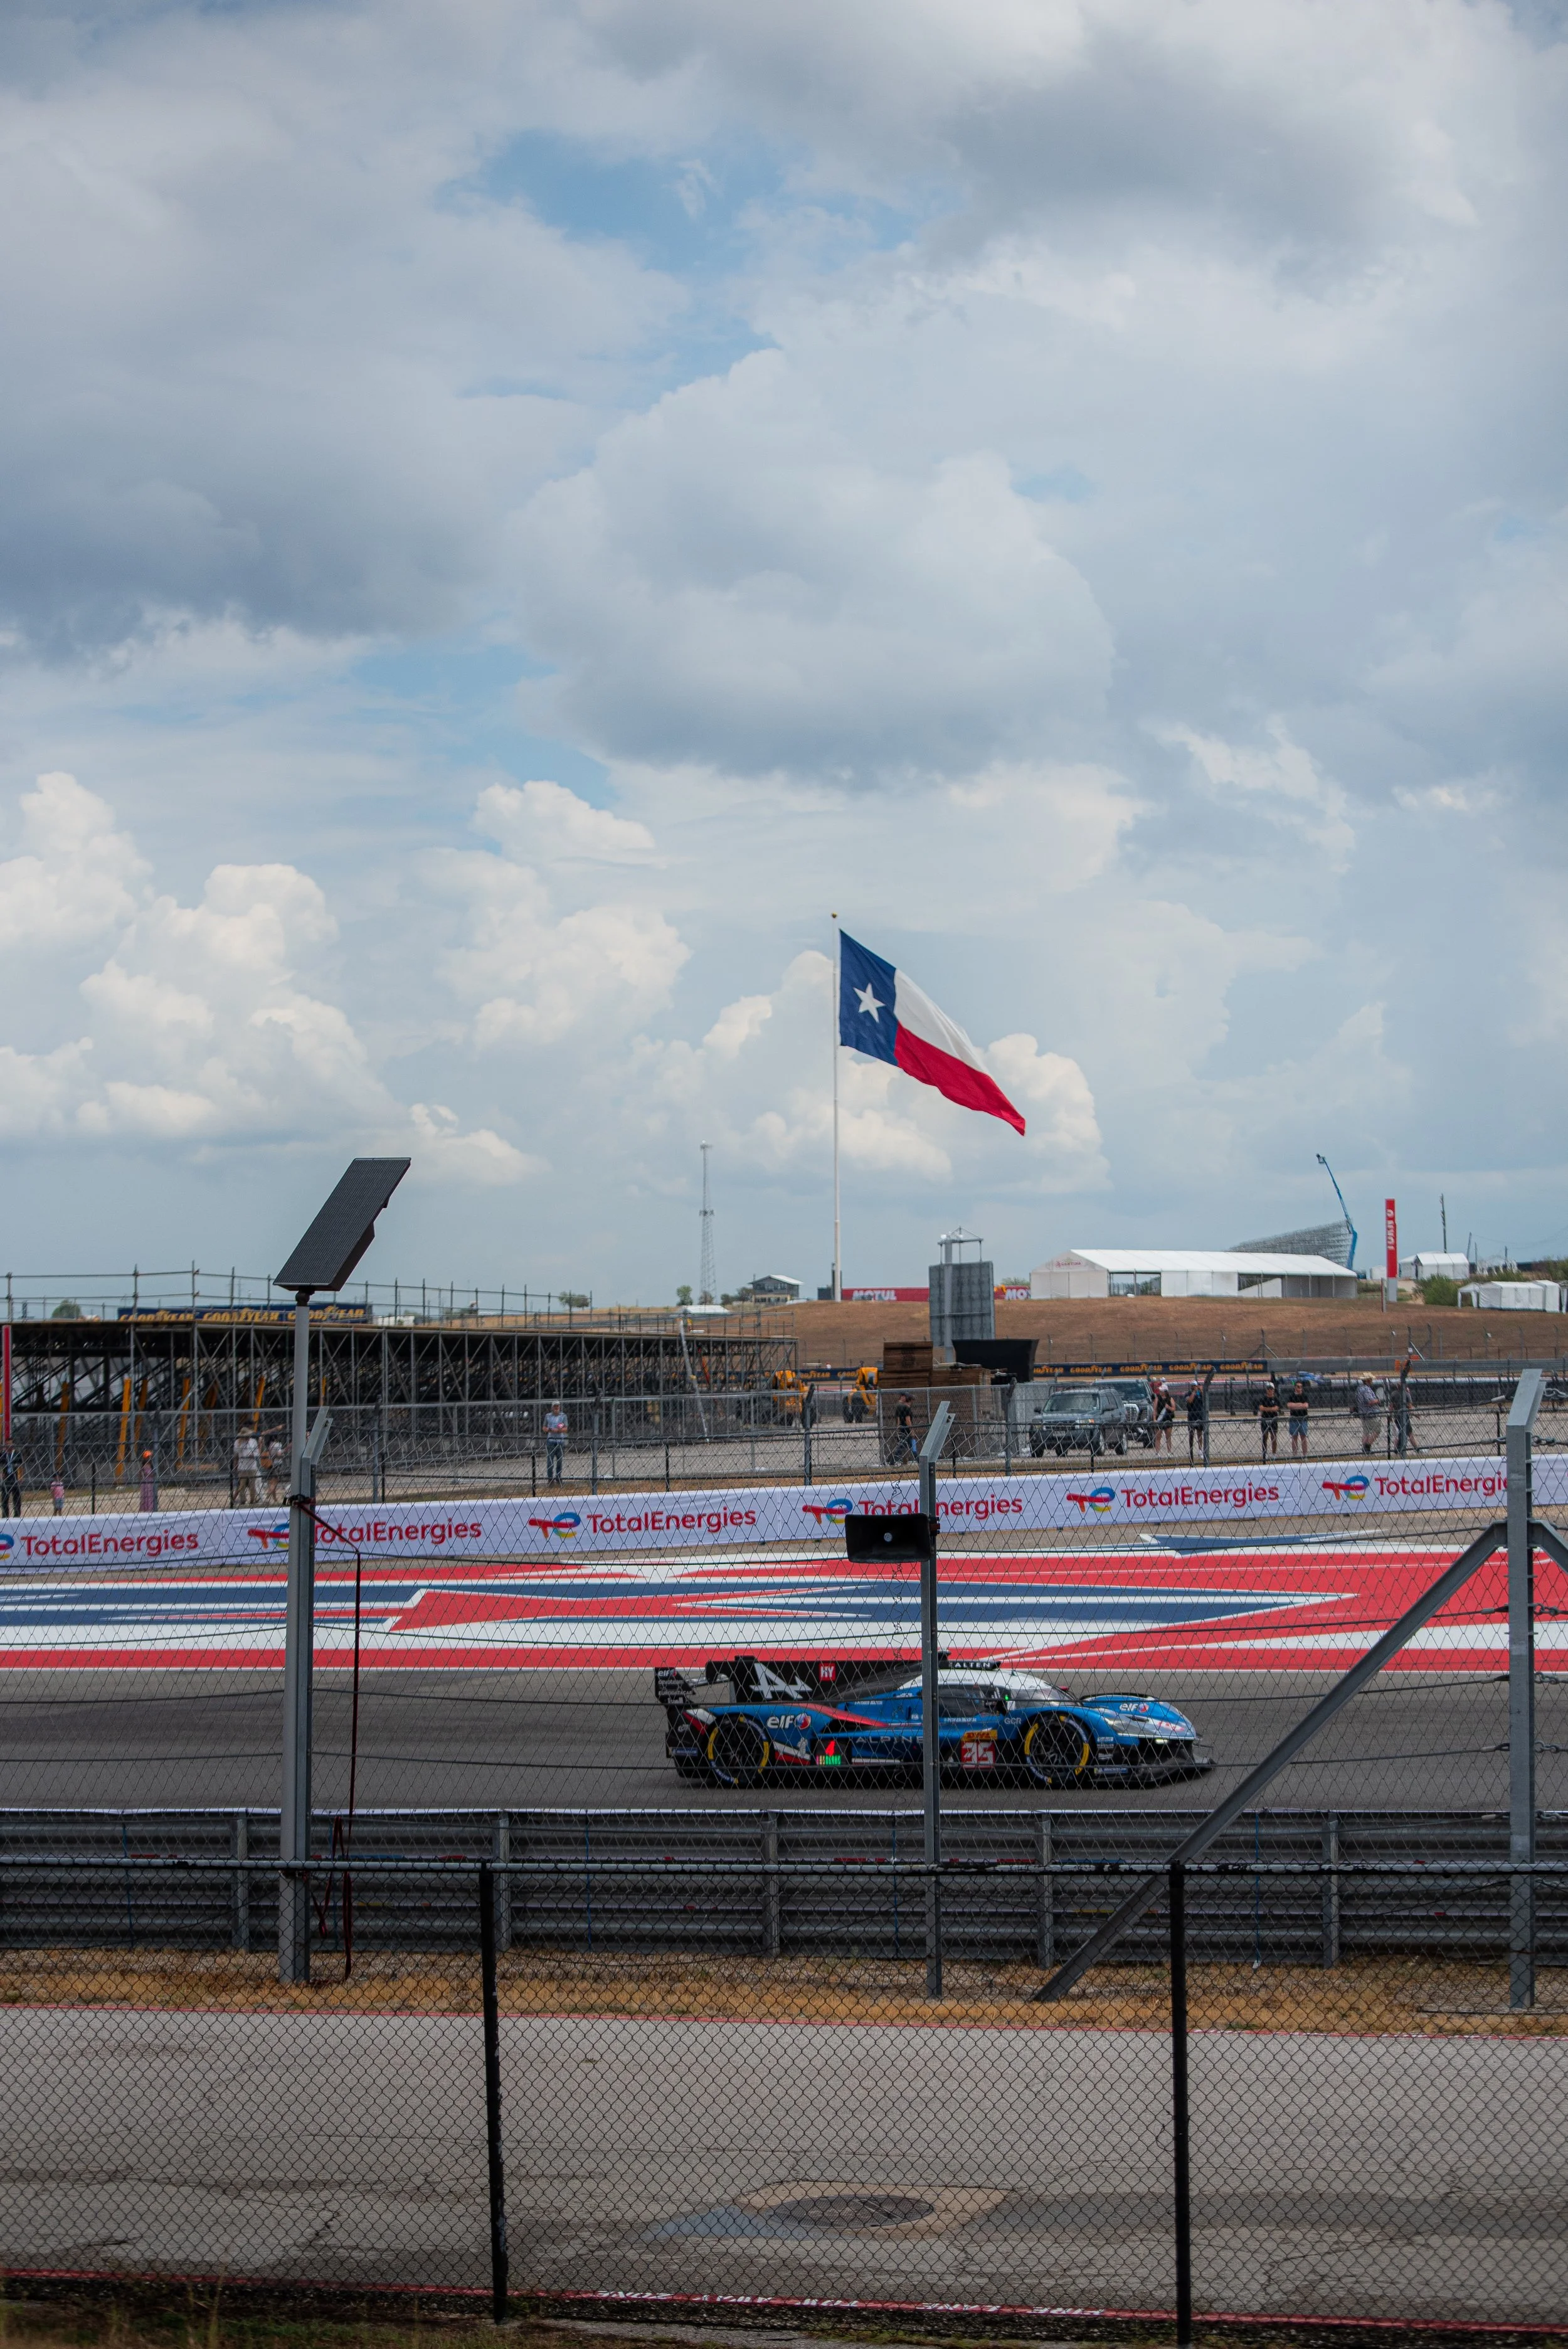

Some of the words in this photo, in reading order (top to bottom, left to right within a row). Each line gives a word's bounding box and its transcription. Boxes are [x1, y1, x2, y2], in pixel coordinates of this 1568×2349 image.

[852, 1290, 898, 1300] MOTUL
[287, 1305, 364, 1320] GODYEAR
[1121, 1482, 1279, 1507] TotalEnergies
[1374, 1471, 1507, 1496] TotalEnergi
[587, 1507, 756, 1532] TotalEnergies
[859, 1494, 1022, 1520] Totalnergies
[21, 1529, 199, 1556] TotalEnergies
[314, 1518, 482, 1544] TotalEnergies
[1120, 1703, 1139, 1711] elf
[766, 1715, 794, 1729] elf
